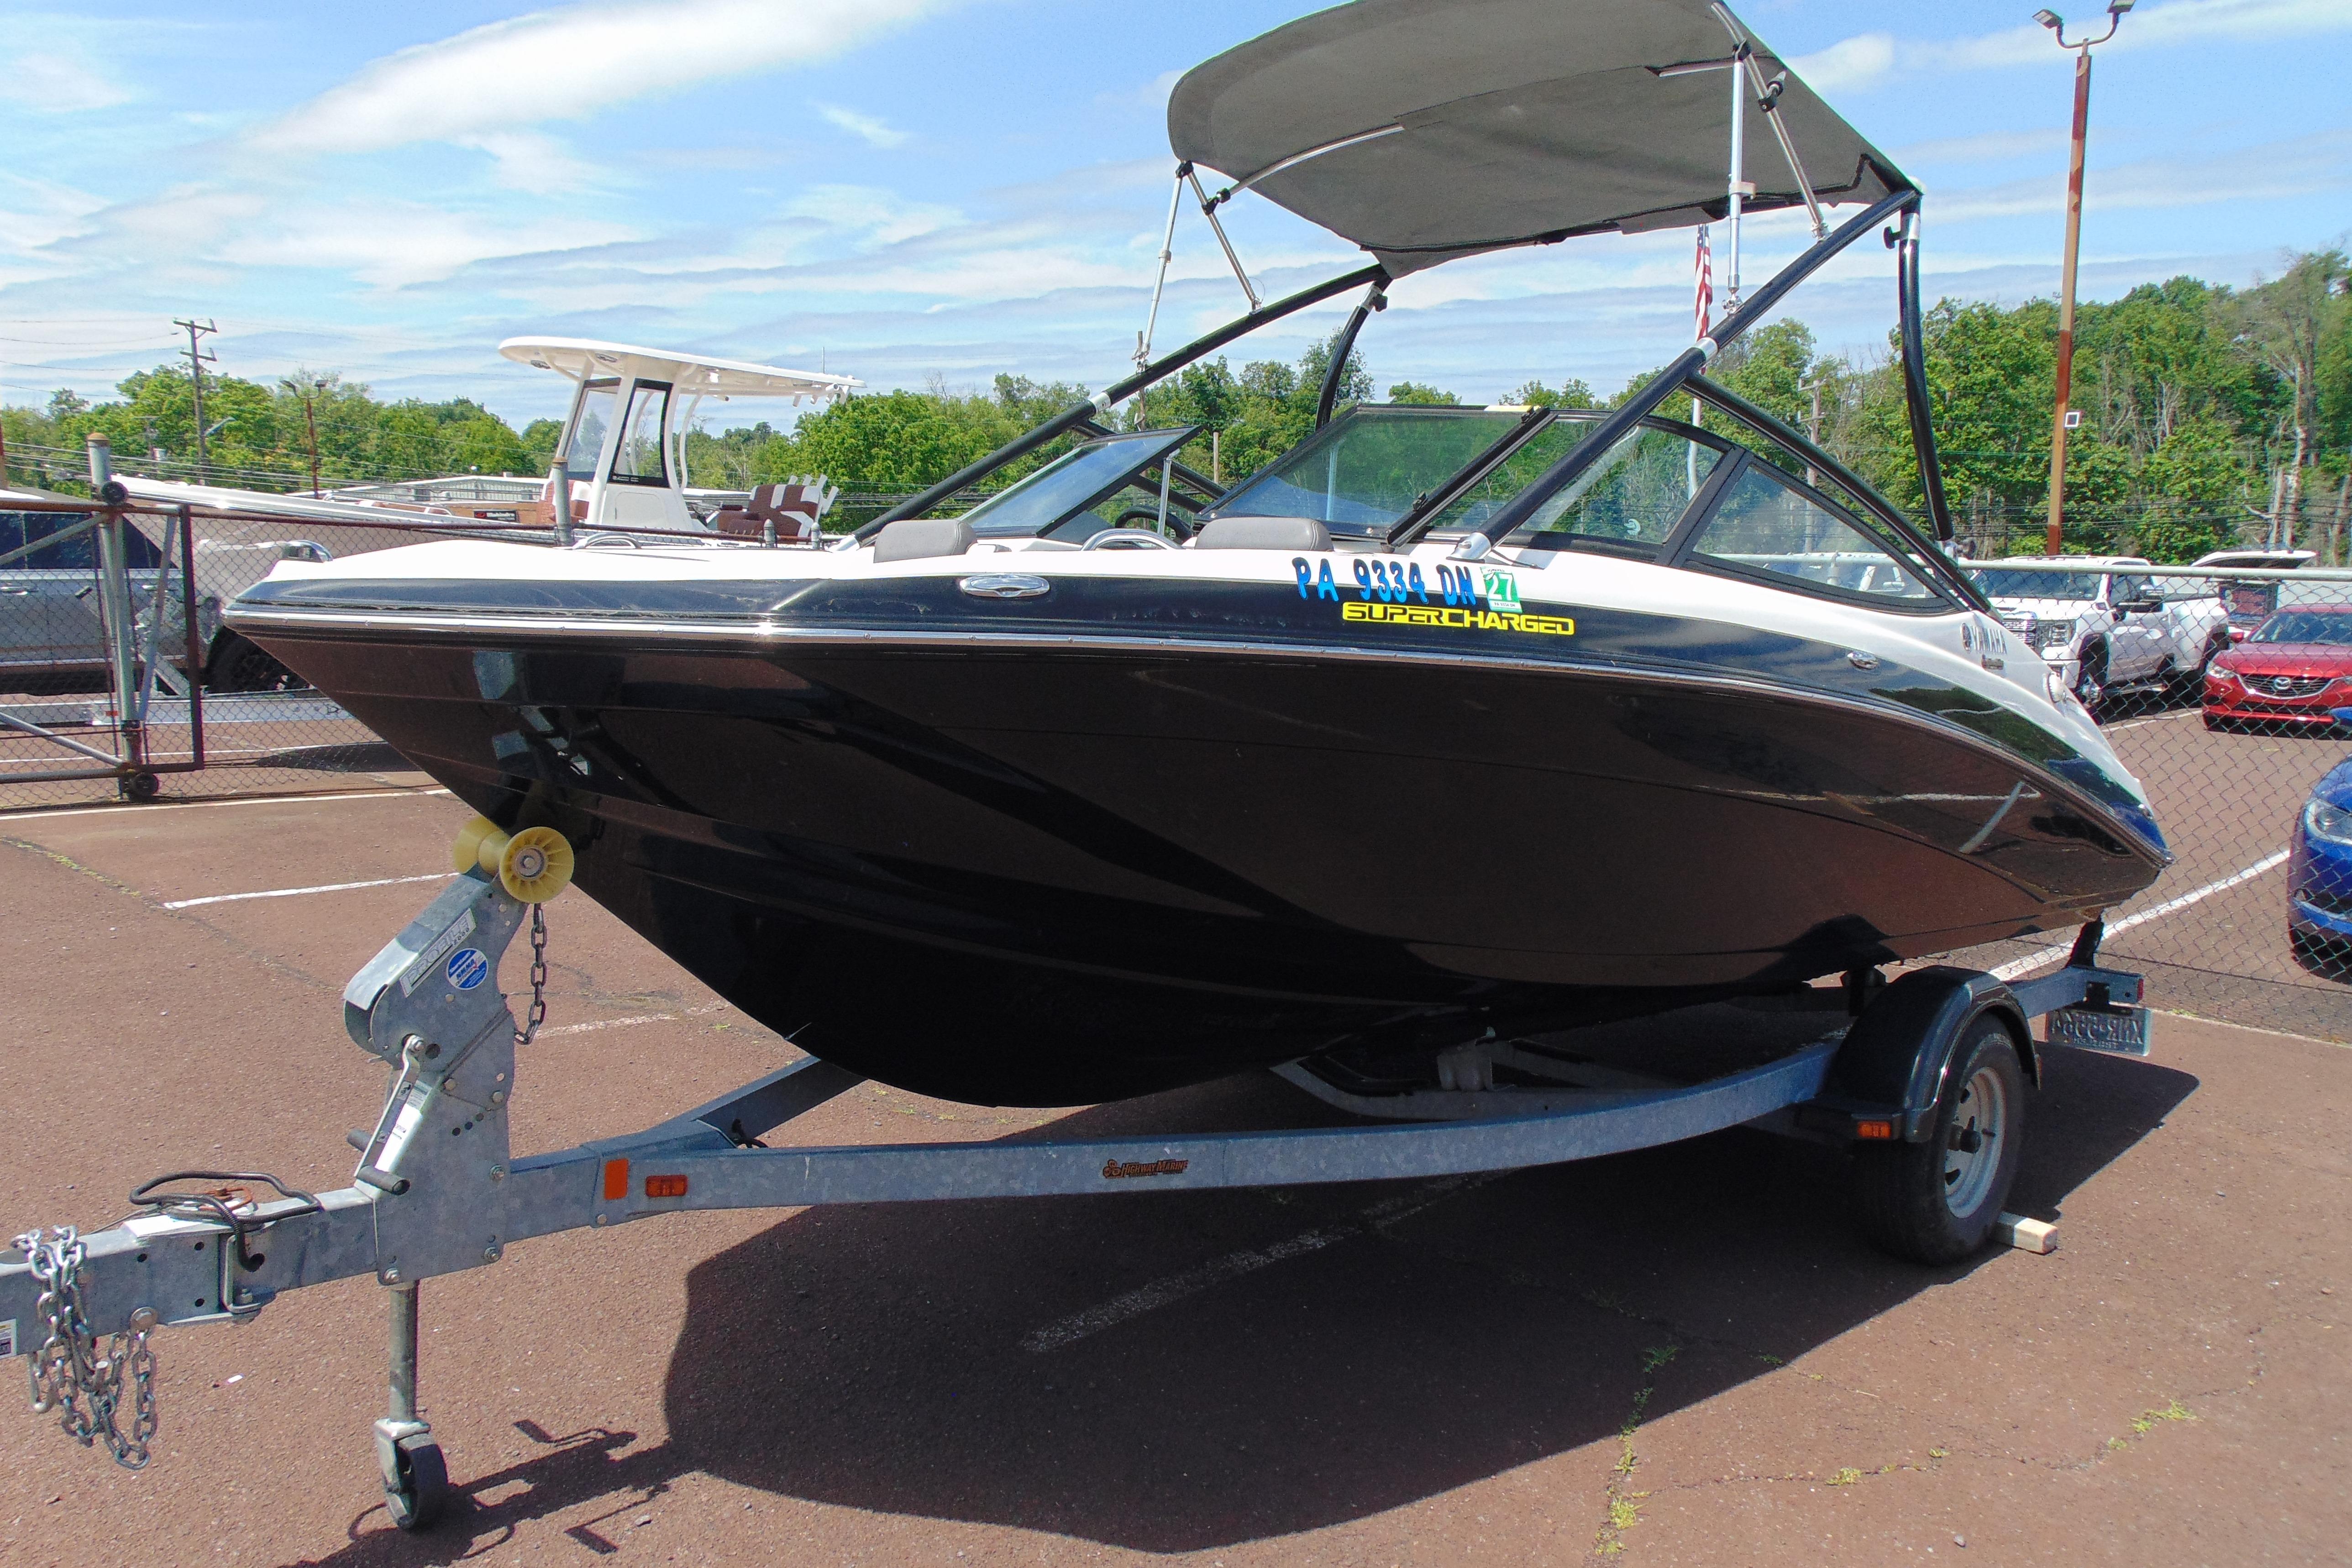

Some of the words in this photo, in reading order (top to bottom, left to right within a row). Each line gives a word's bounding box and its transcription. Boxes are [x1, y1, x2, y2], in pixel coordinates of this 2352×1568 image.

[1292, 556, 1339, 602] PA
[1353, 558, 1429, 604] 9334
[1436, 564, 1476, 606] DN
[1485, 573, 1513, 601] 27
[1342, 602, 1575, 635] SUPERCHARGED
[1970, 625, 2007, 654] YAMAHA
